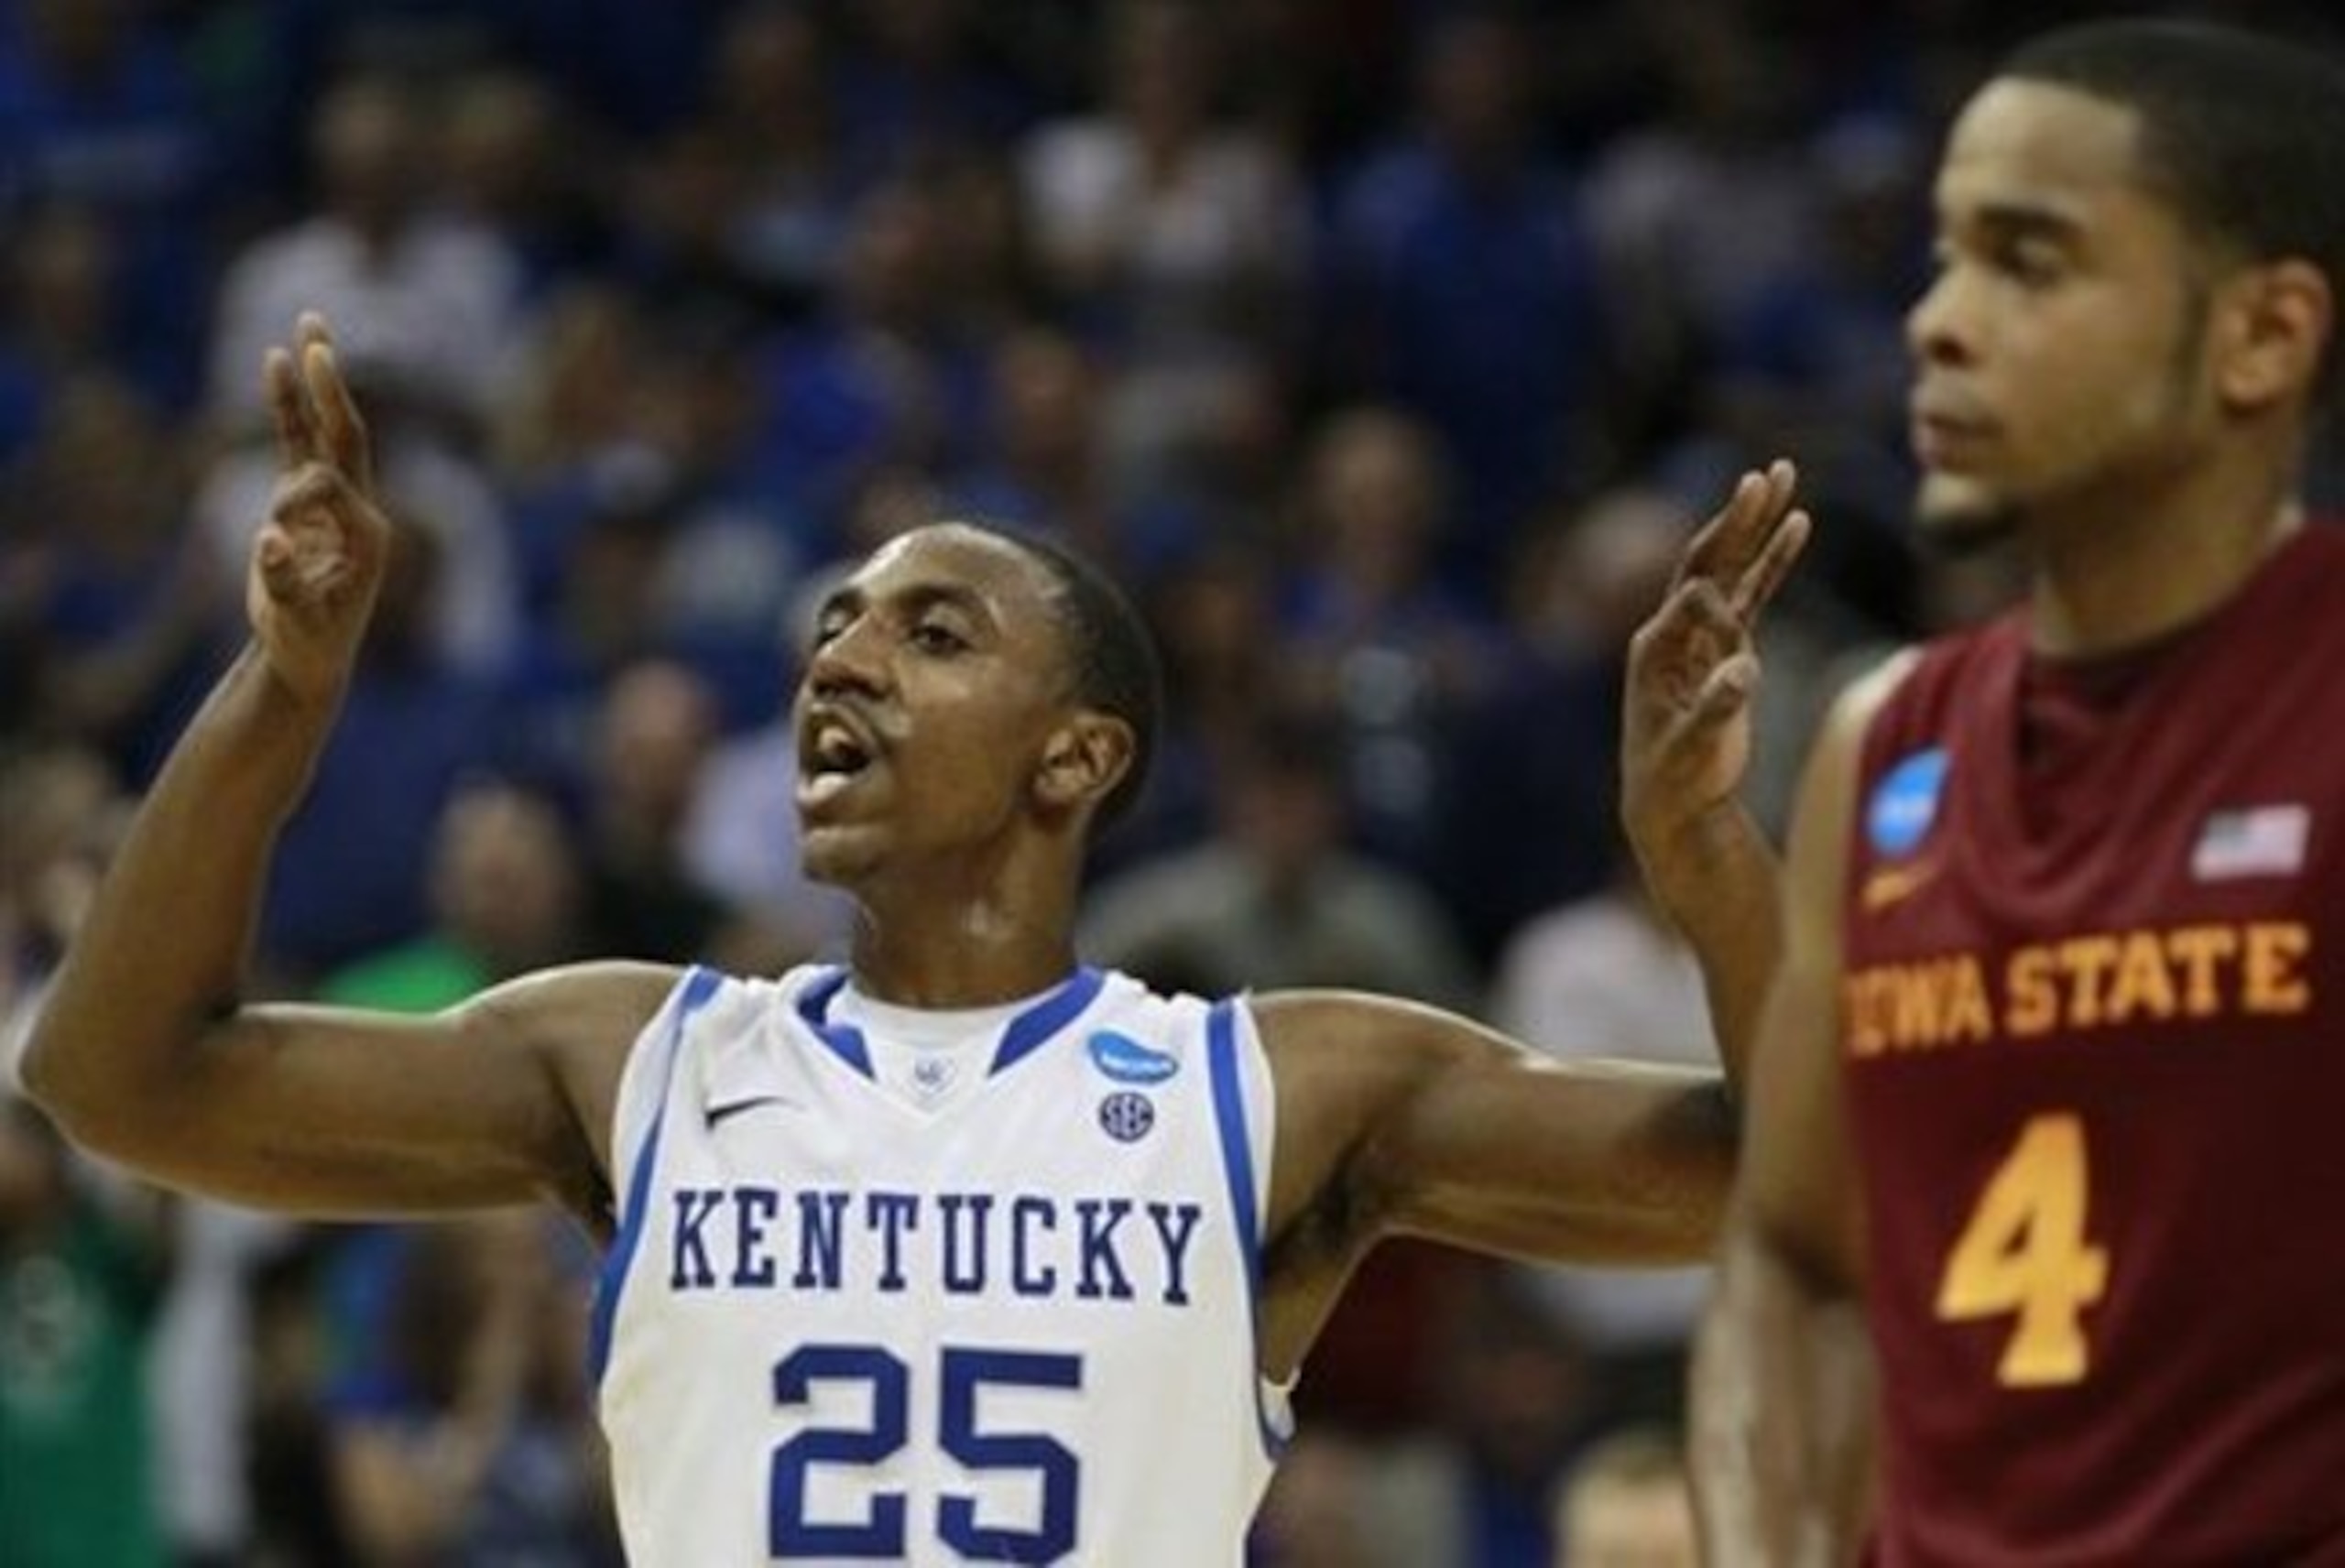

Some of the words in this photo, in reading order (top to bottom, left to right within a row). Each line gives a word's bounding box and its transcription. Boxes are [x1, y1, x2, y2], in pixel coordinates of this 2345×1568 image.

[2006, 923, 2308, 1035] STATE
[1103, 1094, 1152, 1136] SEC
[670, 1187, 1202, 1307] KENTUCKY
[1935, 1112, 2109, 1388] 4
[769, 1344, 1084, 1568] 25
